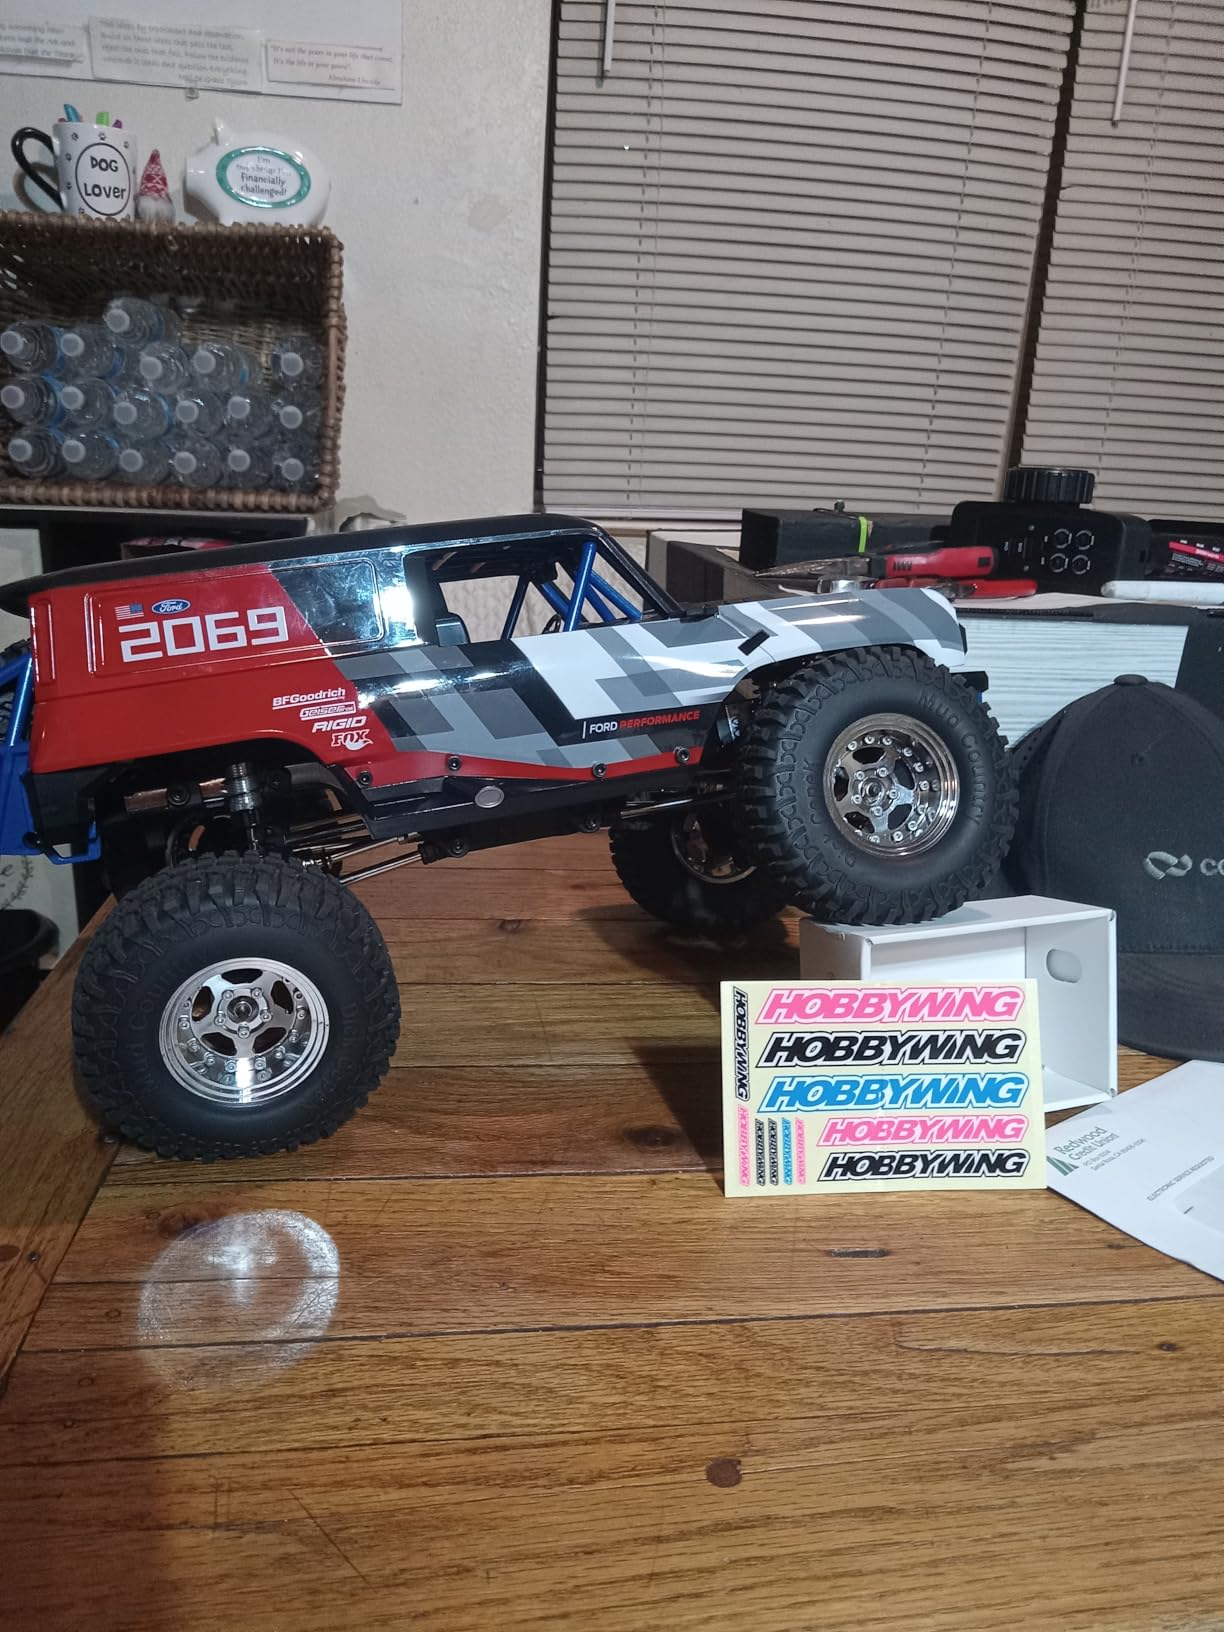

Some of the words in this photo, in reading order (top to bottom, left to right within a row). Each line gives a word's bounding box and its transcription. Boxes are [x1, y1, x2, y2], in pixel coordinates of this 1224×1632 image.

[90, 155, 118, 172] DOG
[240, 183, 287, 198] challenged!
[241, 171, 287, 187] financially
[159, 601, 183, 612] Ford
[118, 605, 289, 663] 2069
[272, 687, 346, 707] BFGoodrich
[312, 716, 367, 733] RIGID
[589, 721, 618, 734] FORD
[619, 709, 700, 729] PERFORMANCE
[331, 729, 373, 750] FOX
[755, 986, 1026, 1024] HOBBYWING
[733, 986, 751, 1102] HOBBYWING
[755, 1028, 1028, 1068] HOBBYWING
[757, 1072, 1029, 1113] HOBBYWING
[816, 1114, 1029, 1147] HOBBYWING
[1053, 1125, 1107, 1154] Redwood
[1068, 1142, 1098, 1161] Credit
[1091, 1131, 1120, 1148] Union
[817, 1148, 1030, 1182] HOBBYWING
